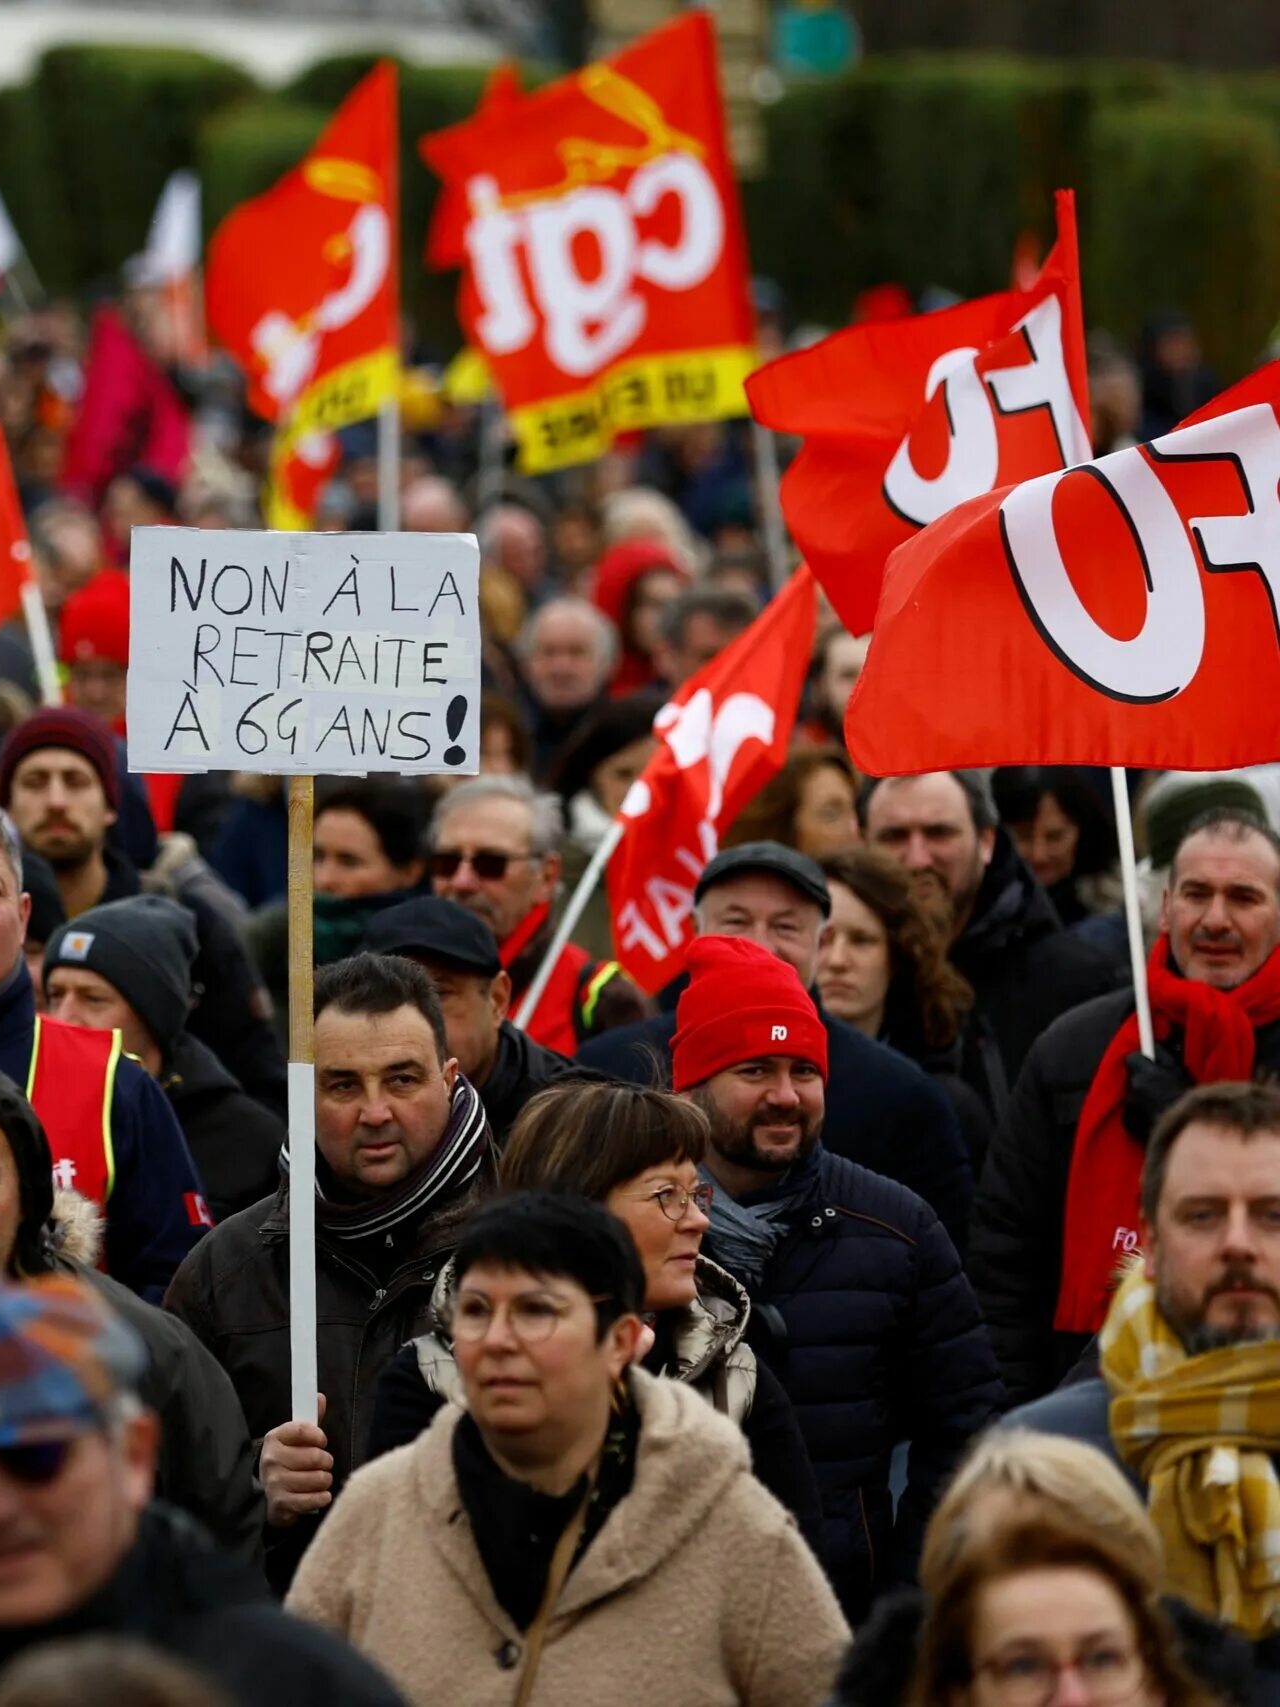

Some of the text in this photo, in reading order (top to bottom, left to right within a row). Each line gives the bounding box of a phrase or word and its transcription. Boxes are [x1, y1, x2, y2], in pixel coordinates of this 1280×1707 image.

[171, 554, 465, 617] NON À LA
[163, 680, 210, 751] À
[235, 692, 303, 756] 64
[771, 1025, 787, 1041] FO
[1112, 1226, 1137, 1251] FO
